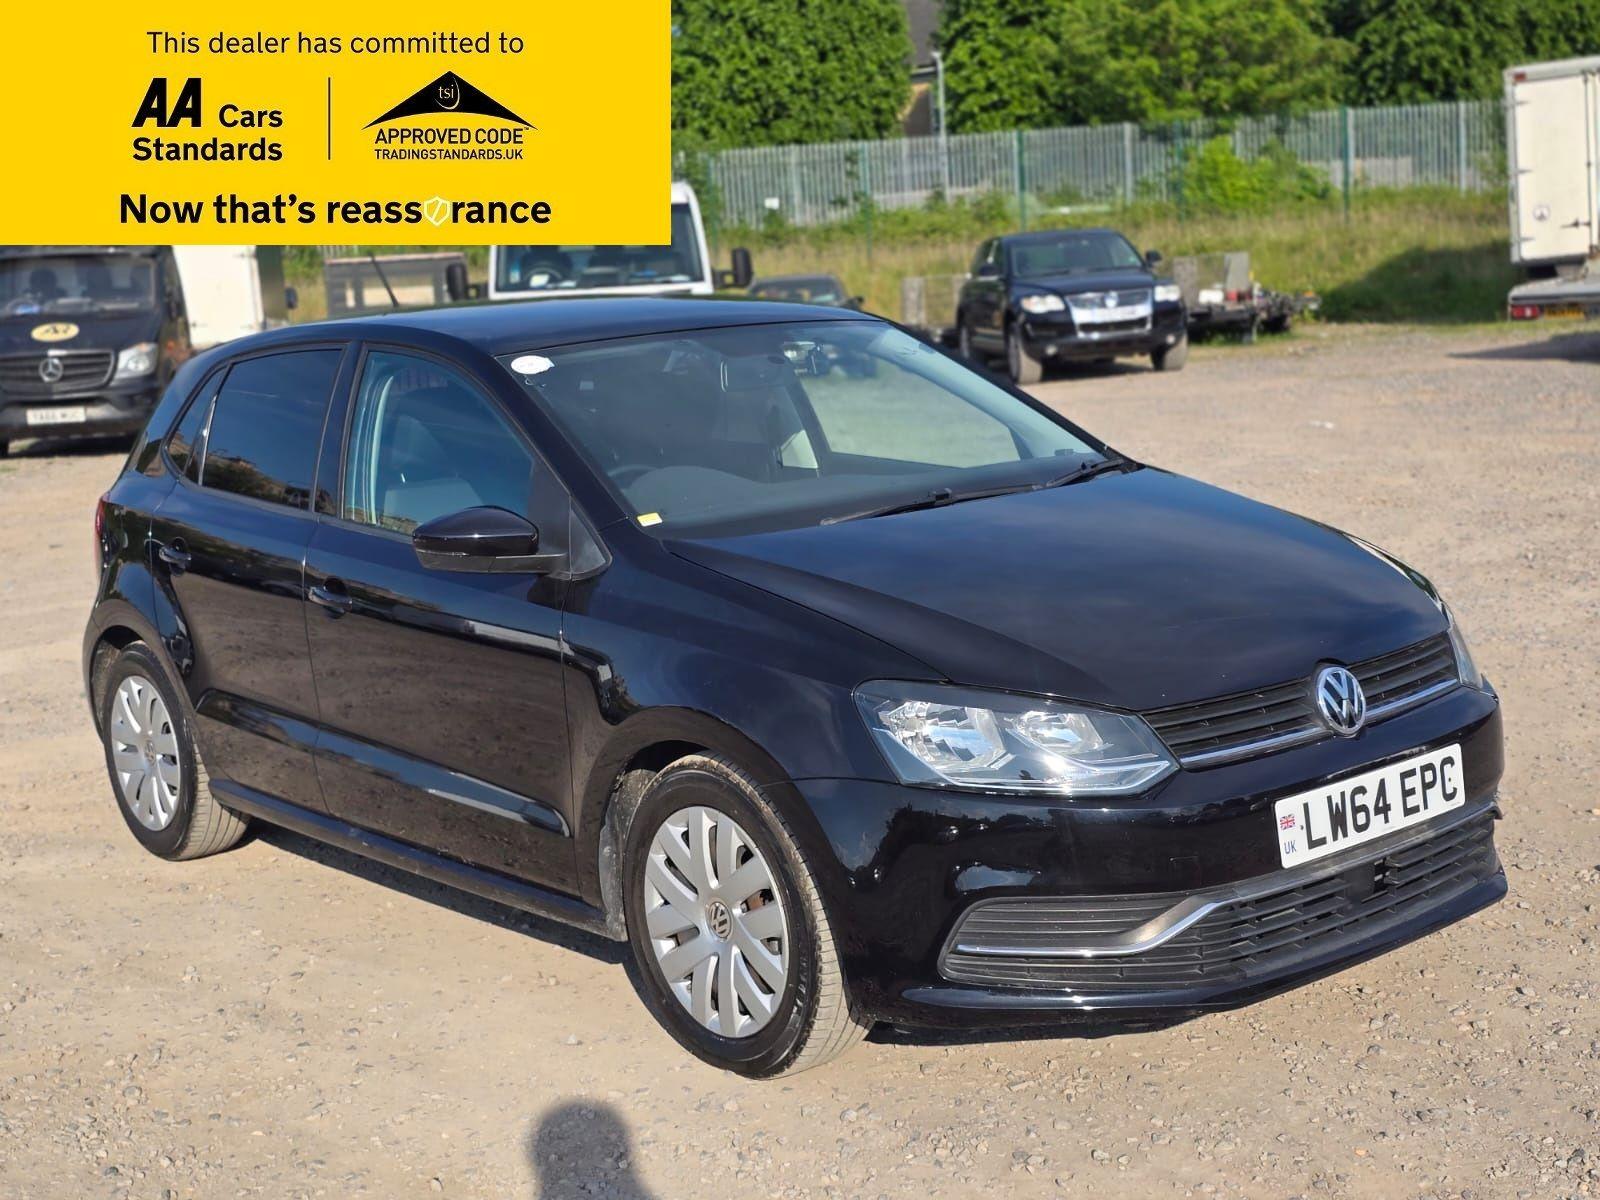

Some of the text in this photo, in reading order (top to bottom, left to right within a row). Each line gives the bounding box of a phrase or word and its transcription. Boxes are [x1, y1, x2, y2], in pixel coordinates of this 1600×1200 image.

[1302, 756, 1459, 850] LW64 EPC
[1284, 839, 1297, 855] UK
